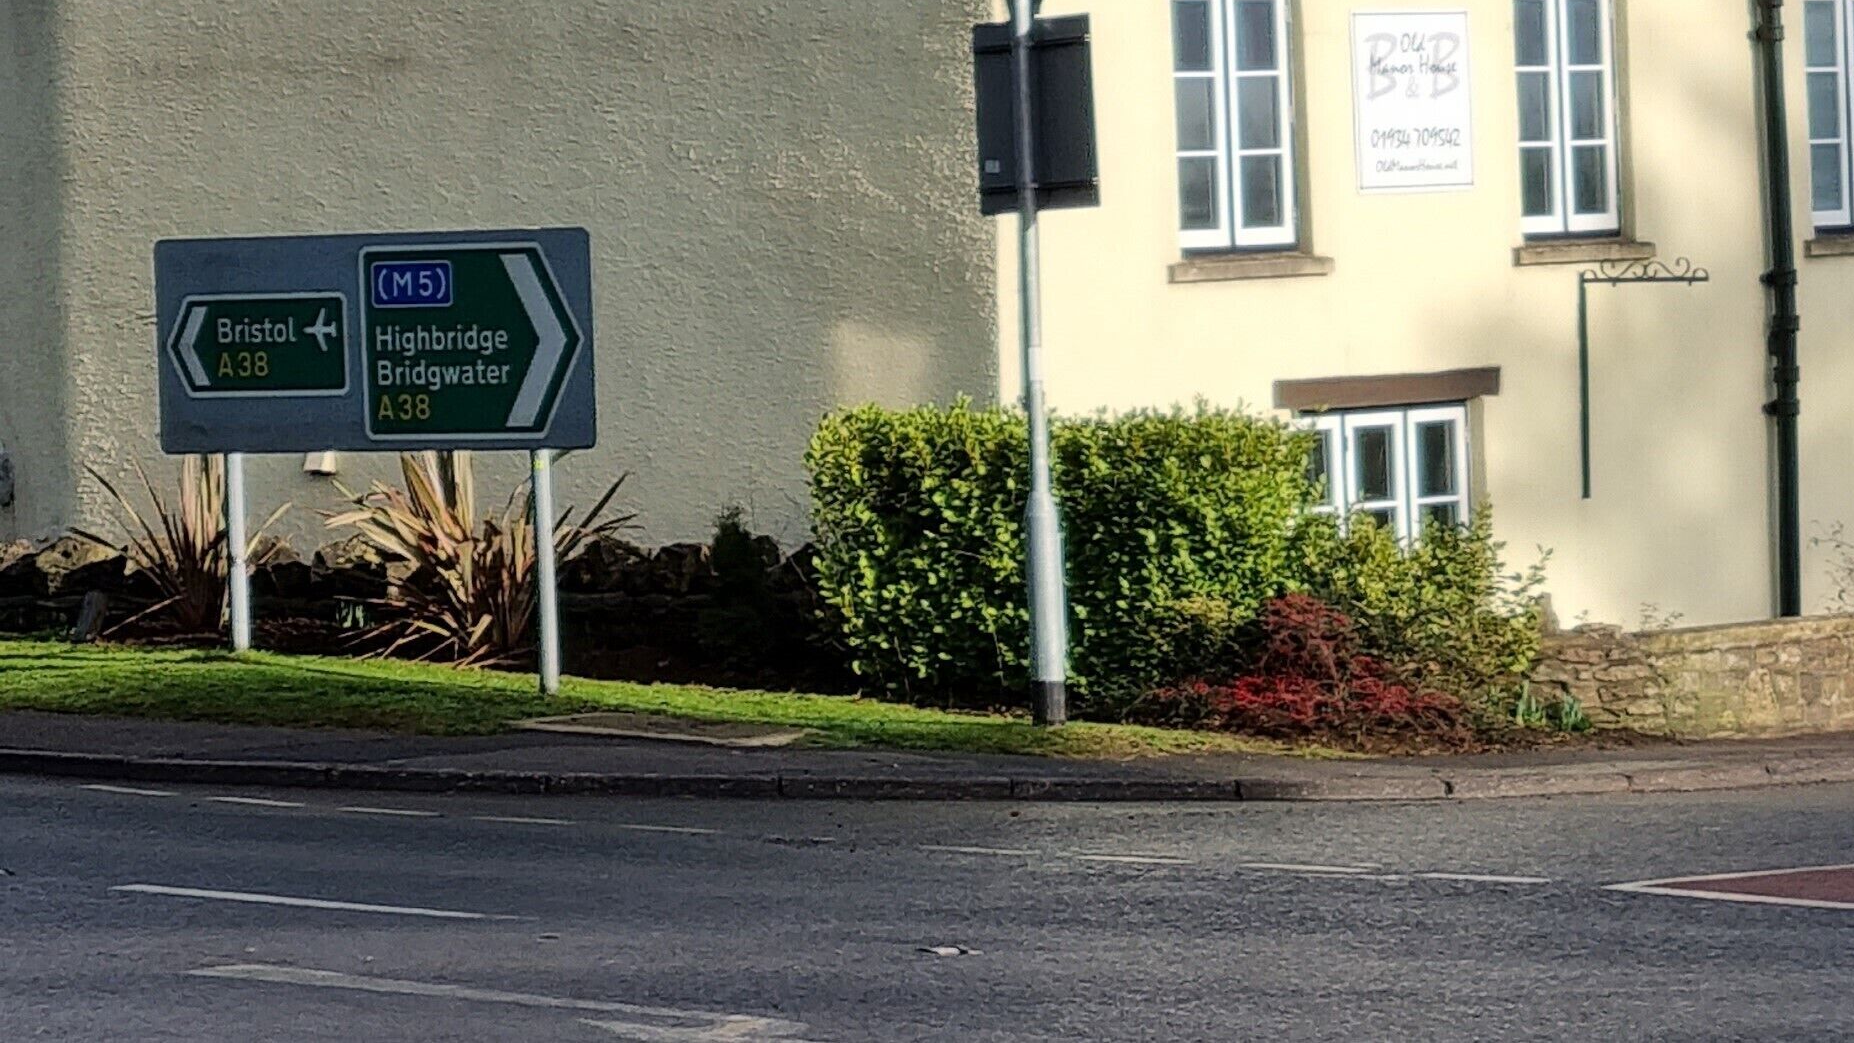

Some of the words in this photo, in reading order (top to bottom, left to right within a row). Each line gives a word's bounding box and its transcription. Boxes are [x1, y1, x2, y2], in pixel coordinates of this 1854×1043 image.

[217, 317, 298, 344] Bristol
[375, 325, 509, 357] Highbridge
[218, 352, 270, 377] A38
[376, 359, 511, 392] Bridgwater
[378, 394, 431, 420] A38
